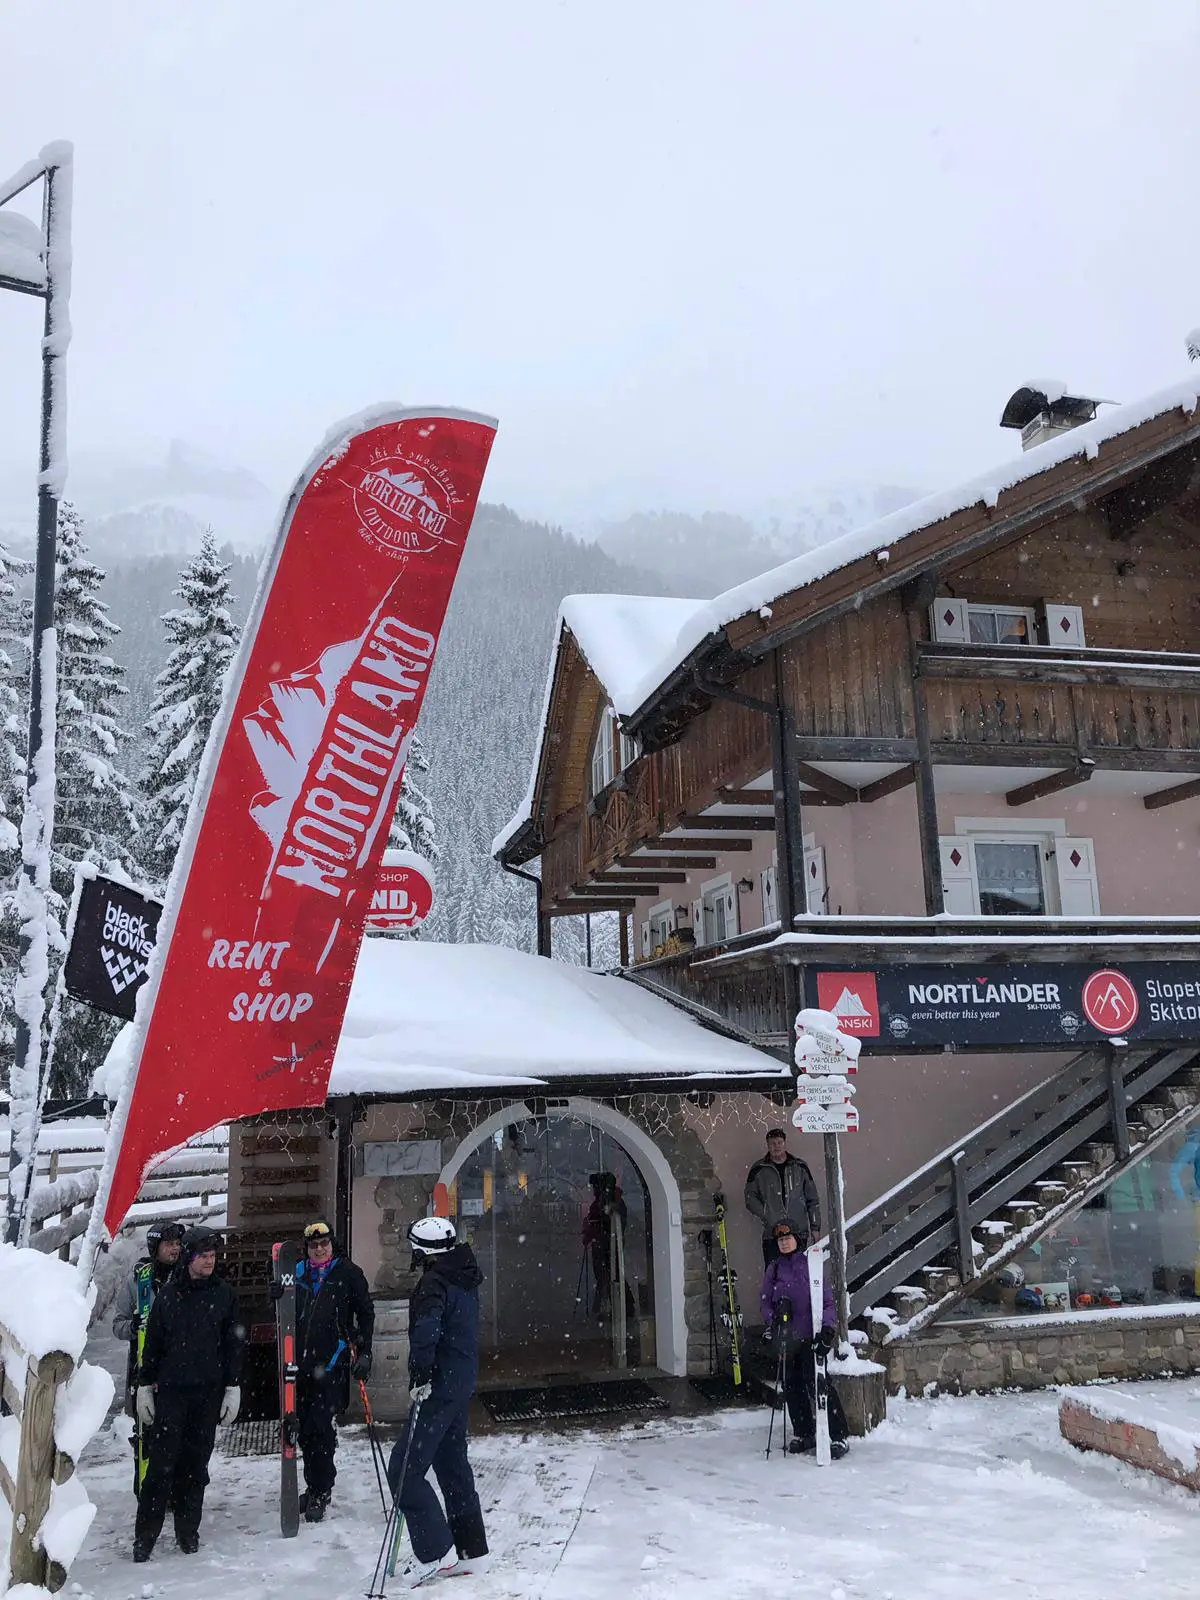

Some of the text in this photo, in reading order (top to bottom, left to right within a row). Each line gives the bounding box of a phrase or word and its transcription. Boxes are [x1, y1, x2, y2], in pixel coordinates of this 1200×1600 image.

[396, 443, 404, 455] &
[359, 473, 447, 535] NORTHLAND
[363, 507, 420, 548] OUTDOOR
[276, 616, 436, 898] NORTHLAND
[380, 873, 409, 882] SHOP
[105, 900, 150, 939] black
[102, 922, 154, 958] crows
[207, 939, 291, 970] RENT
[258, 970, 273, 987] &
[908, 983, 1061, 1004] NORTLANDER
[228, 992, 314, 1022] SHOP
[911, 1009, 1001, 1022] even better this year
[1027, 1003, 1062, 1011] SKI-TOURS
[1150, 1002, 1200, 1022] Skito
[836, 1018, 873, 1029] ANSKI
[806, 1115, 826, 1123] COLAC
